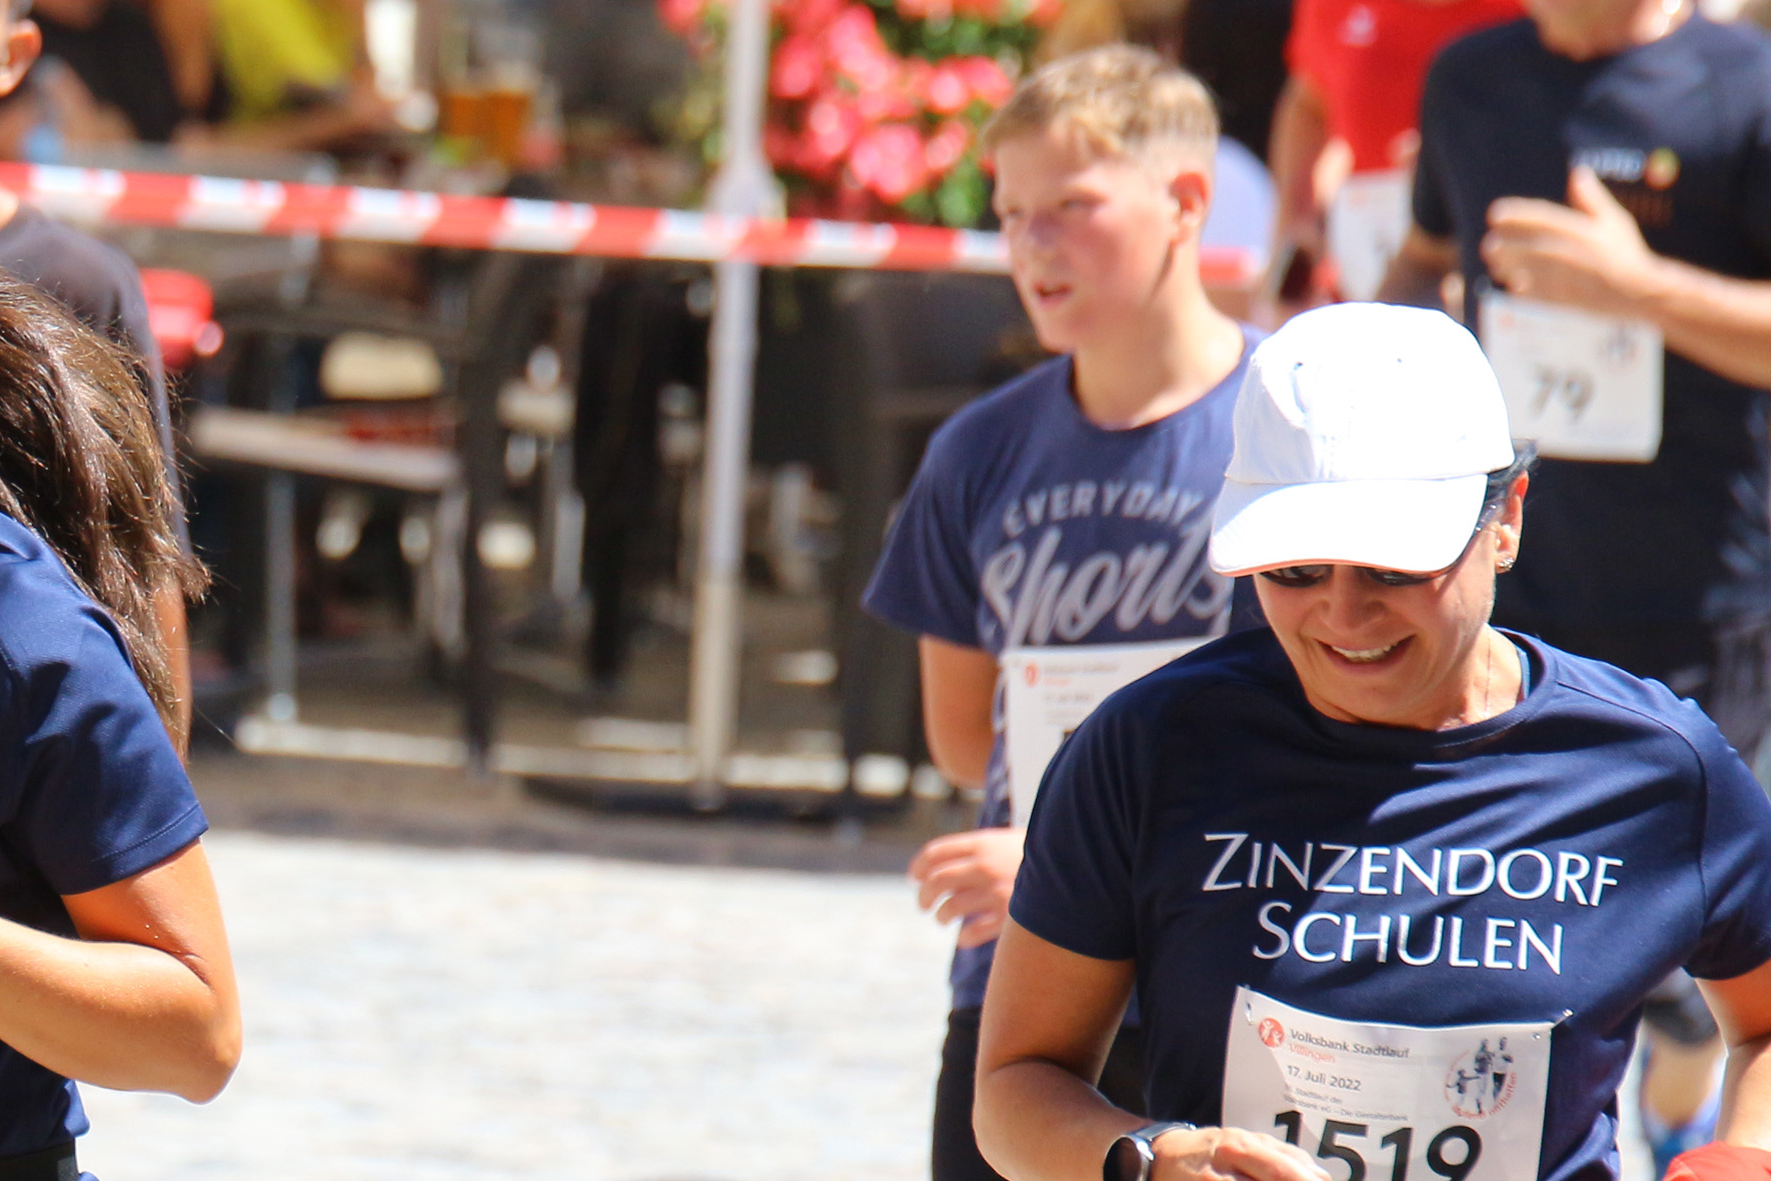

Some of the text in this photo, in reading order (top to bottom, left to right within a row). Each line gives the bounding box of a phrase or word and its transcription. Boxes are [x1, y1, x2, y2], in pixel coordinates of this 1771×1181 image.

[1003, 480, 1204, 538] EVERYDAY
[1202, 833, 1624, 907] ZINZENDORF
[1252, 902, 1562, 975] SCHULEN
[1290, 1029, 1410, 1059] Volksbank Stadtlauf
[1288, 1065, 1362, 1091] 17. Juli 2022
